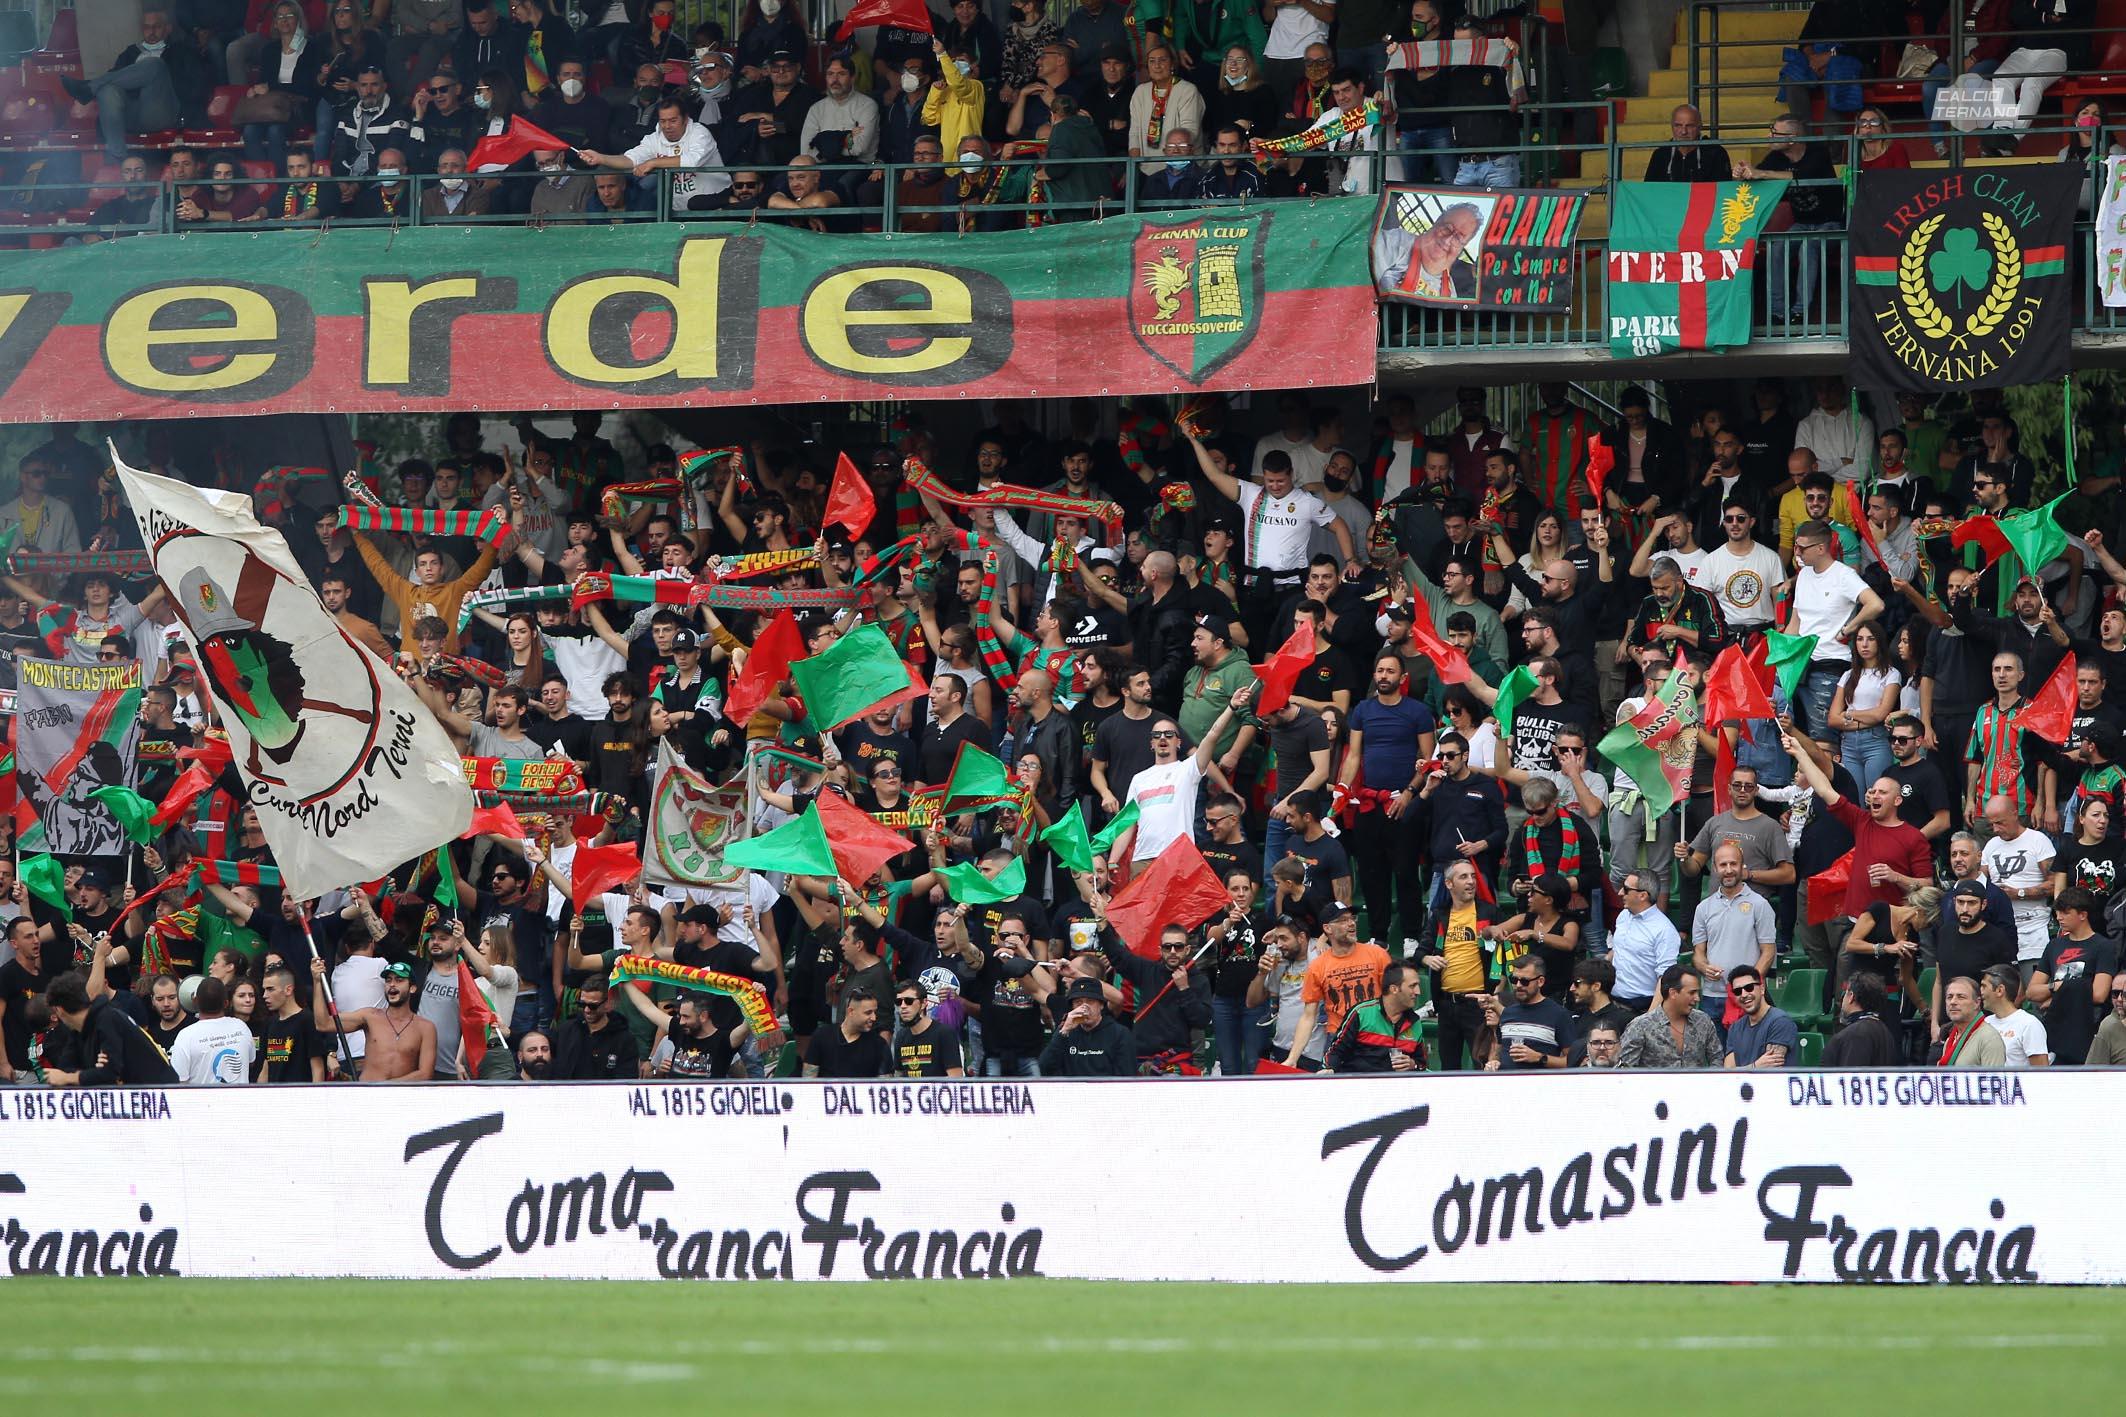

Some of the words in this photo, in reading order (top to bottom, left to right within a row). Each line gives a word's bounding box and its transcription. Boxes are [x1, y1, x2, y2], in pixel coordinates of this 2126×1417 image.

[1884, 175, 1965, 238] IRISH
[1973, 173, 2041, 230] CLAN
[1213, 226, 1249, 239] CLUB
[1487, 194, 1583, 248] GIANNI
[1484, 252, 1507, 277] Per
[1512, 251, 1568, 280] Sempre
[1496, 286, 1522, 304] con
[1528, 279, 1554, 304] Noi
[1141, 319, 1245, 336] roccarossoverde
[1611, 315, 1681, 338] PARK
[1874, 300, 2000, 382] TERNANA
[1998, 296, 2043, 359] 1991
[1632, 336, 1662, 357] 89
[1257, 514, 1297, 527] NICUSANO
[1065, 634, 1108, 644] ONVERSE
[22, 660, 141, 691] MONTECASTRILLI
[1516, 715, 1563, 732] BULLET
[1522, 728, 1550, 741] CLUB
[521, 762, 565, 776] FORZA
[876, 811, 932, 826] TERNAN
[621, 956, 654, 975] MAI
[657, 962, 701, 983] SOLA
[629, 1088, 656, 1116] AL
[662, 1088, 706, 1116] 1815
[824, 1086, 863, 1114] DAL
[869, 1086, 912, 1114] 1815
[917, 1085, 1035, 1114] GIOIELLERIA
[1788, 1076, 1832, 1105] DAL
[1840, 1076, 1888, 1105] 1815
[1894, 1076, 2025, 1105] GIOIELLERIA
[15, 1092, 56, 1119] 1815
[62, 1092, 171, 1119] GIOIELLERIA
[1321, 1082, 1754, 1272] Tomasini
[796, 1169, 1046, 1279] Francia
[1757, 1165, 2038, 1283] Francia
